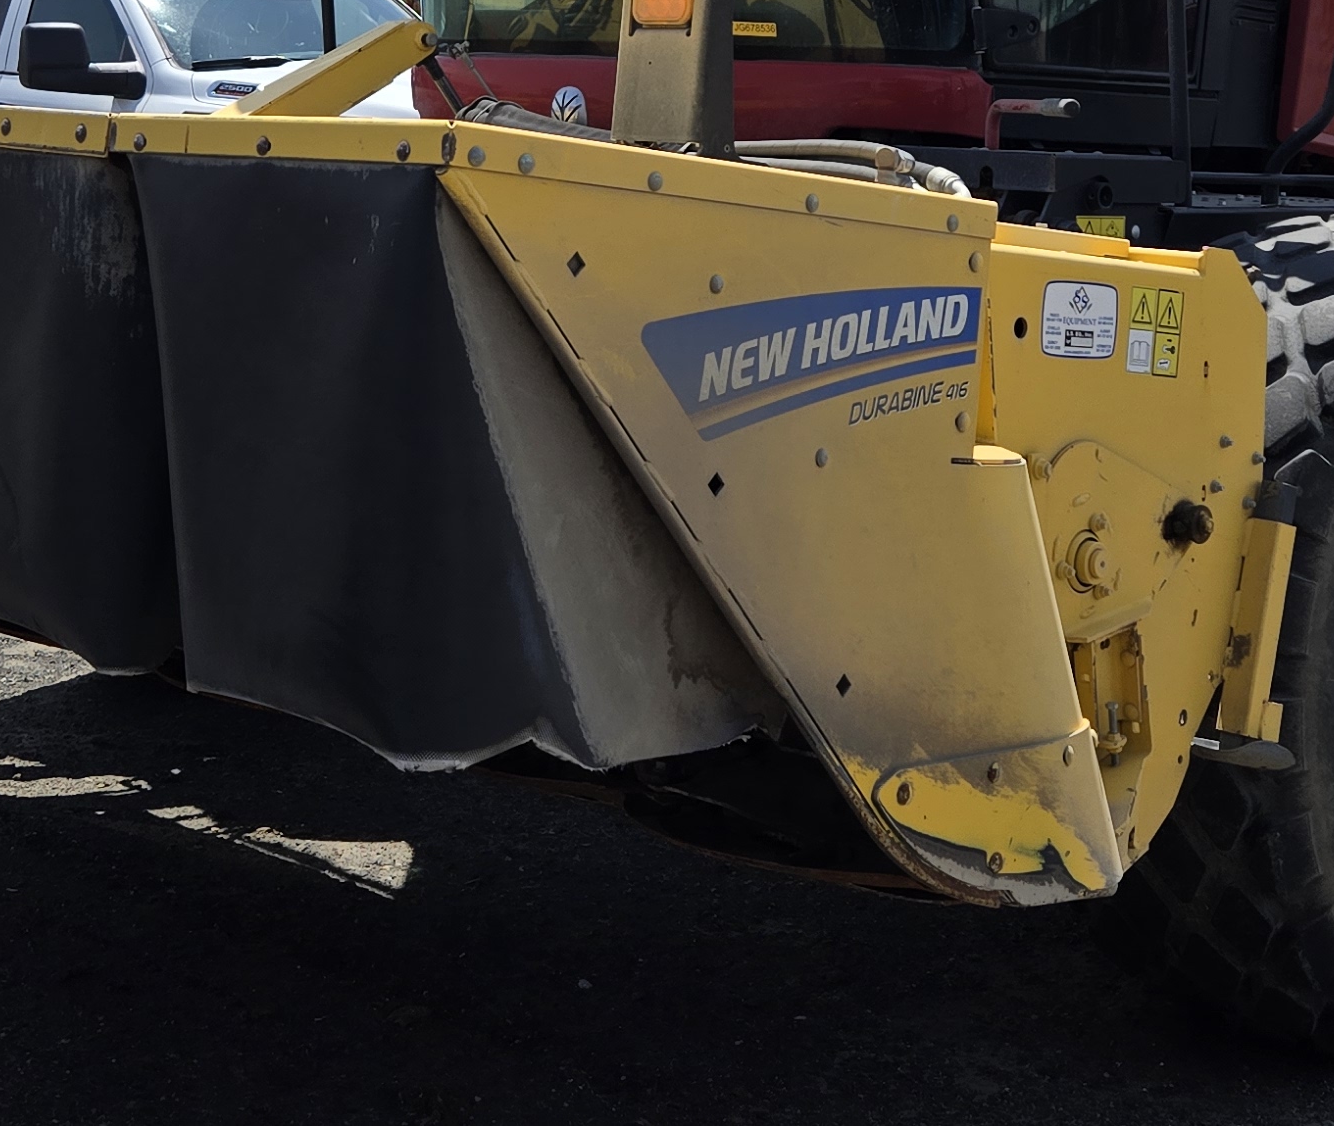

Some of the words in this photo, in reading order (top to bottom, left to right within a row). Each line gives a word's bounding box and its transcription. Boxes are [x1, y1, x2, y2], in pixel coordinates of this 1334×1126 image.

[1062, 316, 1097, 326] EQUIPMENT
[698, 327, 797, 403] NEW
[800, 293, 970, 370] HOLLAND
[849, 380, 946, 425] DURABINE
[946, 381, 970, 401] 416
